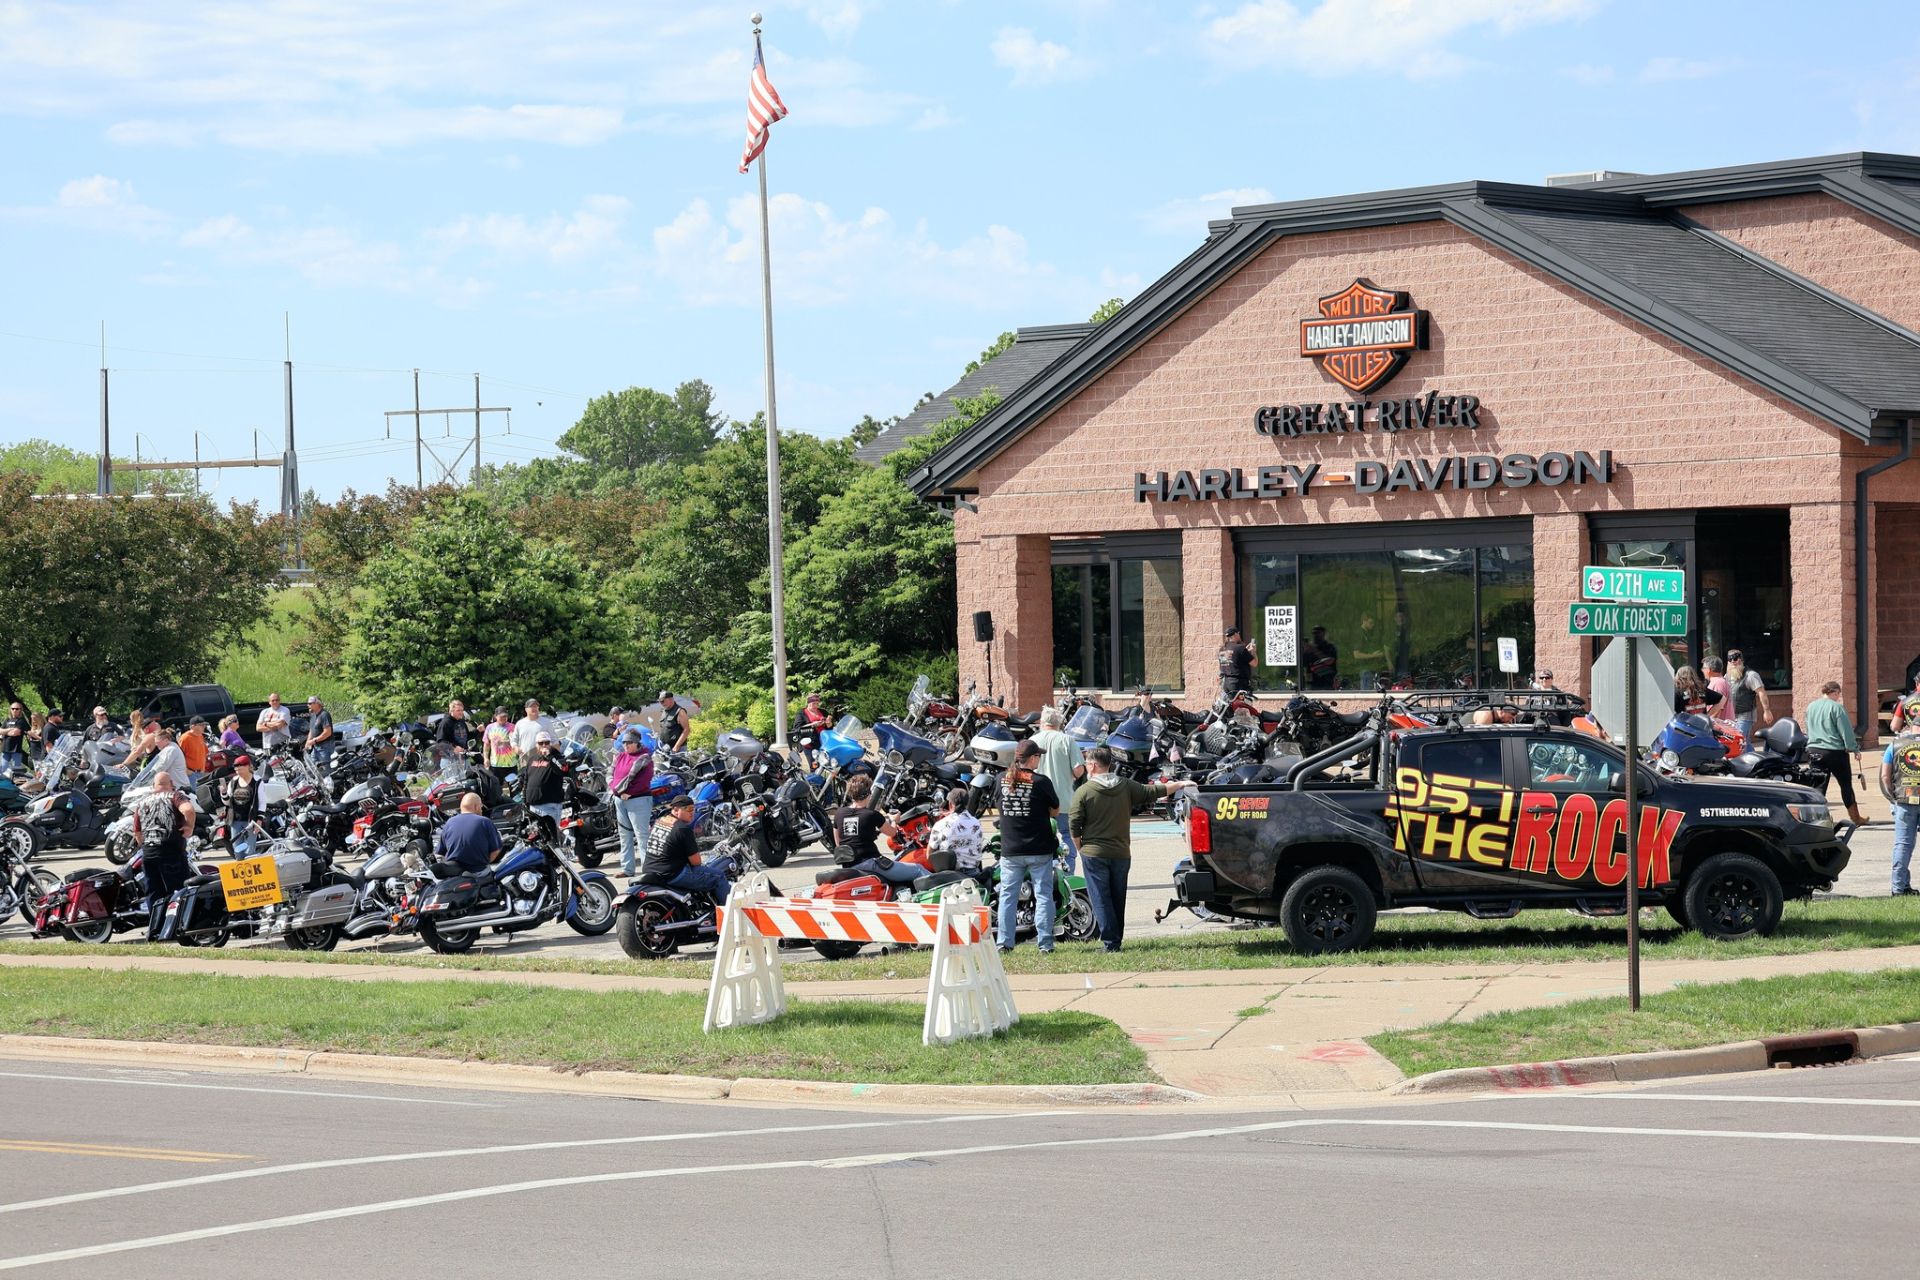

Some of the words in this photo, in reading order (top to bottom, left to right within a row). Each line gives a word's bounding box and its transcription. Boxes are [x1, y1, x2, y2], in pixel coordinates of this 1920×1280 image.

[1330, 289, 1385, 317] MOTOR
[1306, 319, 1409, 349] HARLEY-DAVIDSON
[1331, 351, 1384, 383] CYCLES
[1255, 400, 1370, 438] GREAT
[1377, 390, 1480, 433] RIVER
[1609, 572, 1642, 597] 12TH
[1647, 579, 1665, 592] AVE
[1671, 580, 1678, 593] S
[1268, 608, 1293, 617] RIDE
[1269, 617, 1292, 626] MAP
[1594, 607, 1619, 631] OAK
[1623, 608, 1667, 632] FOREST
[1671, 614, 1682, 626] DR
[1238, 797, 1271, 810] SEVEN
[1388, 766, 1515, 823] 95.7
[1215, 796, 1239, 821] 95
[1239, 811, 1251, 819] OFF
[1251, 811, 1268, 819] ROAD
[1699, 807, 1770, 818] 957THEROCK.COM
[1384, 808, 1510, 867] THE
[1509, 790, 1686, 889] ROCK
[232, 863, 262, 879] LOOK
[227, 882, 276, 897] MOTORCYCLES
